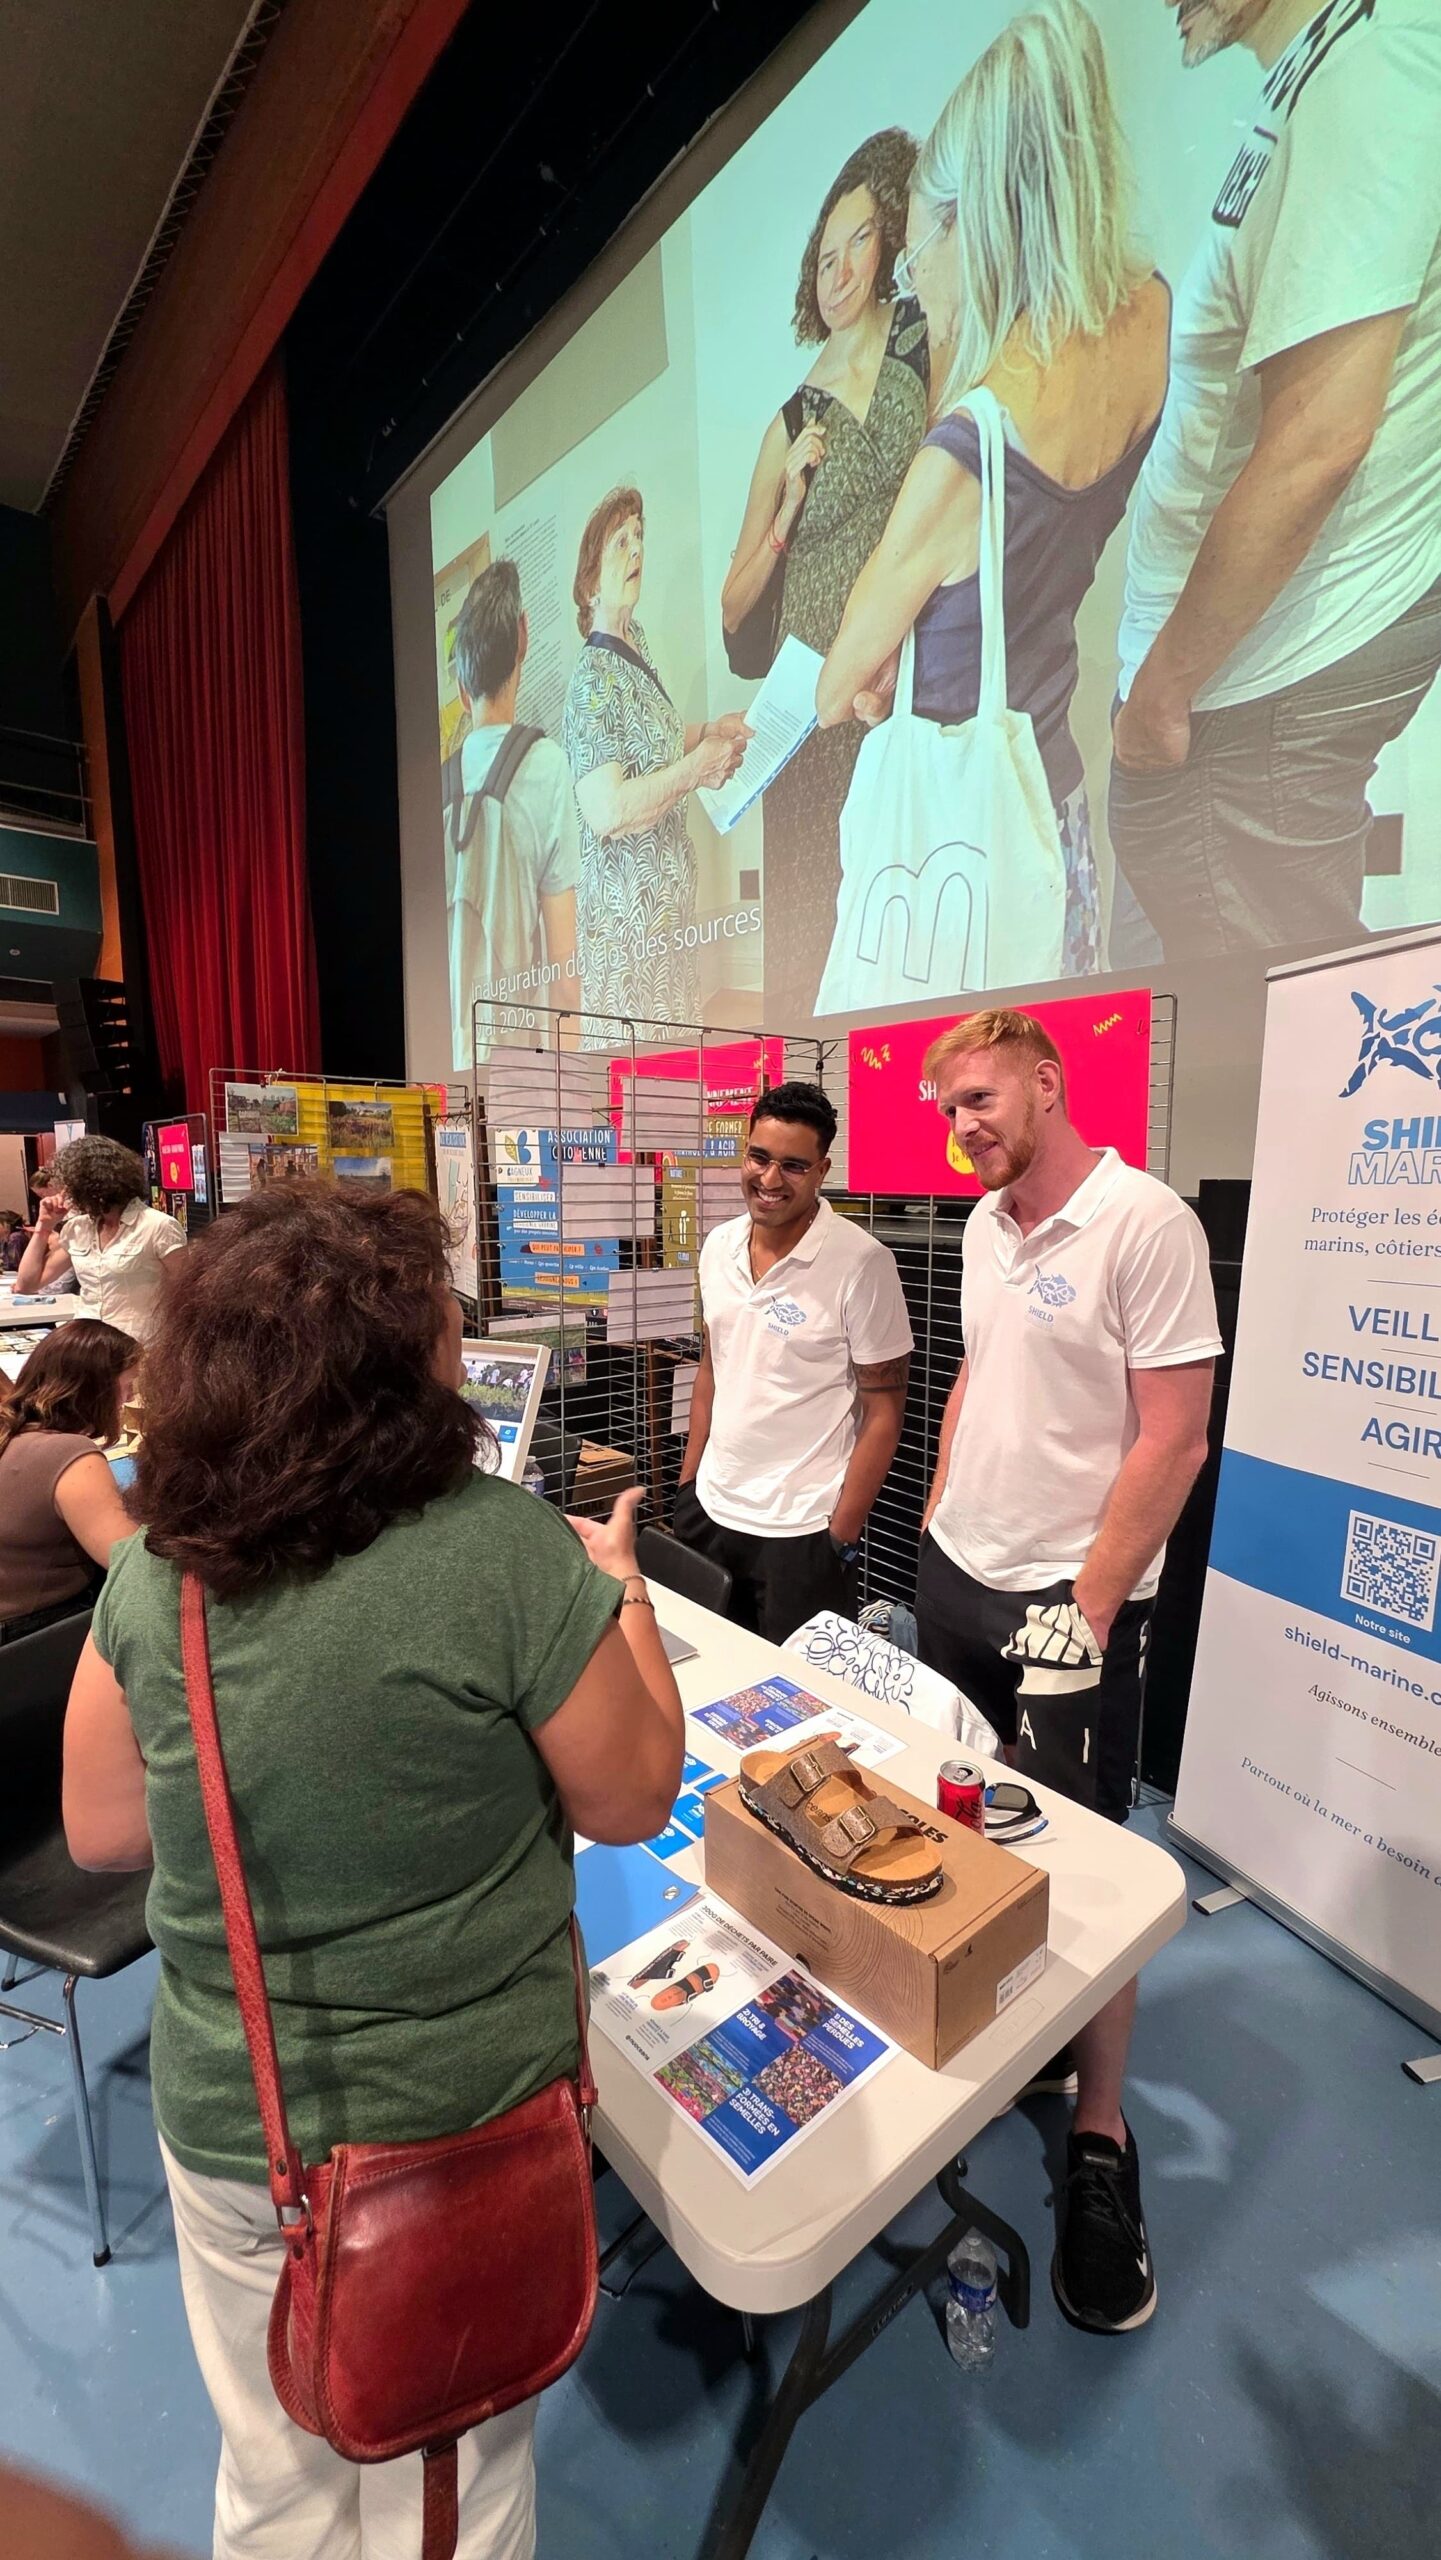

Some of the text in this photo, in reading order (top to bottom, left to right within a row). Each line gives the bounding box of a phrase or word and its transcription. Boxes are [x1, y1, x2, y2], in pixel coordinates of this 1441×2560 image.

[471, 961, 561, 1002] Inauguration
[635, 932, 668, 960] des
[674, 907, 763, 951] sources
[500, 1007, 535, 1034] 2026
[547, 1130, 611, 1144] ASSOCIATION
[718, 1140, 736, 1156] AGIR
[1362, 1116, 1441, 1151] SHI
[1311, 1207, 1441, 1229] Protéger les é
[1304, 1236, 1369, 1257] marins,
[767, 1322, 789, 1336] SHIELD
[1028, 1305, 1054, 1323] SHIELD
[1349, 1305, 1439, 1342] VEILL
[1302, 1352, 1441, 1400] SENSIBIL
[1360, 1417, 1441, 1460] AGIR
[1355, 1613, 1411, 1645] Notre site
[1284, 1626, 1441, 1706] shield-marine.c
[1308, 1684, 1441, 1757] Agissons ensemble
[1241, 1756, 1431, 1880] Partout où la mer a besoin
[716, 1917, 725, 1926] DE
[724, 1923, 750, 1944] DÉCHETS
[748, 1941, 762, 1953] PAR
[760, 1950, 779, 1967] PAIRE
[736, 2012, 767, 2041] BROYAGE
[749, 2013, 762, 2026] TRI
[828, 2018, 865, 2048] SEMELLES
[839, 2017, 855, 2031] DES
[822, 2022, 856, 2049] PERDUES
[728, 2098, 766, 2135] SEMELLES
[742, 2087, 775, 2119] 3) TRANS-
[767, 2122, 780, 2136] EN
